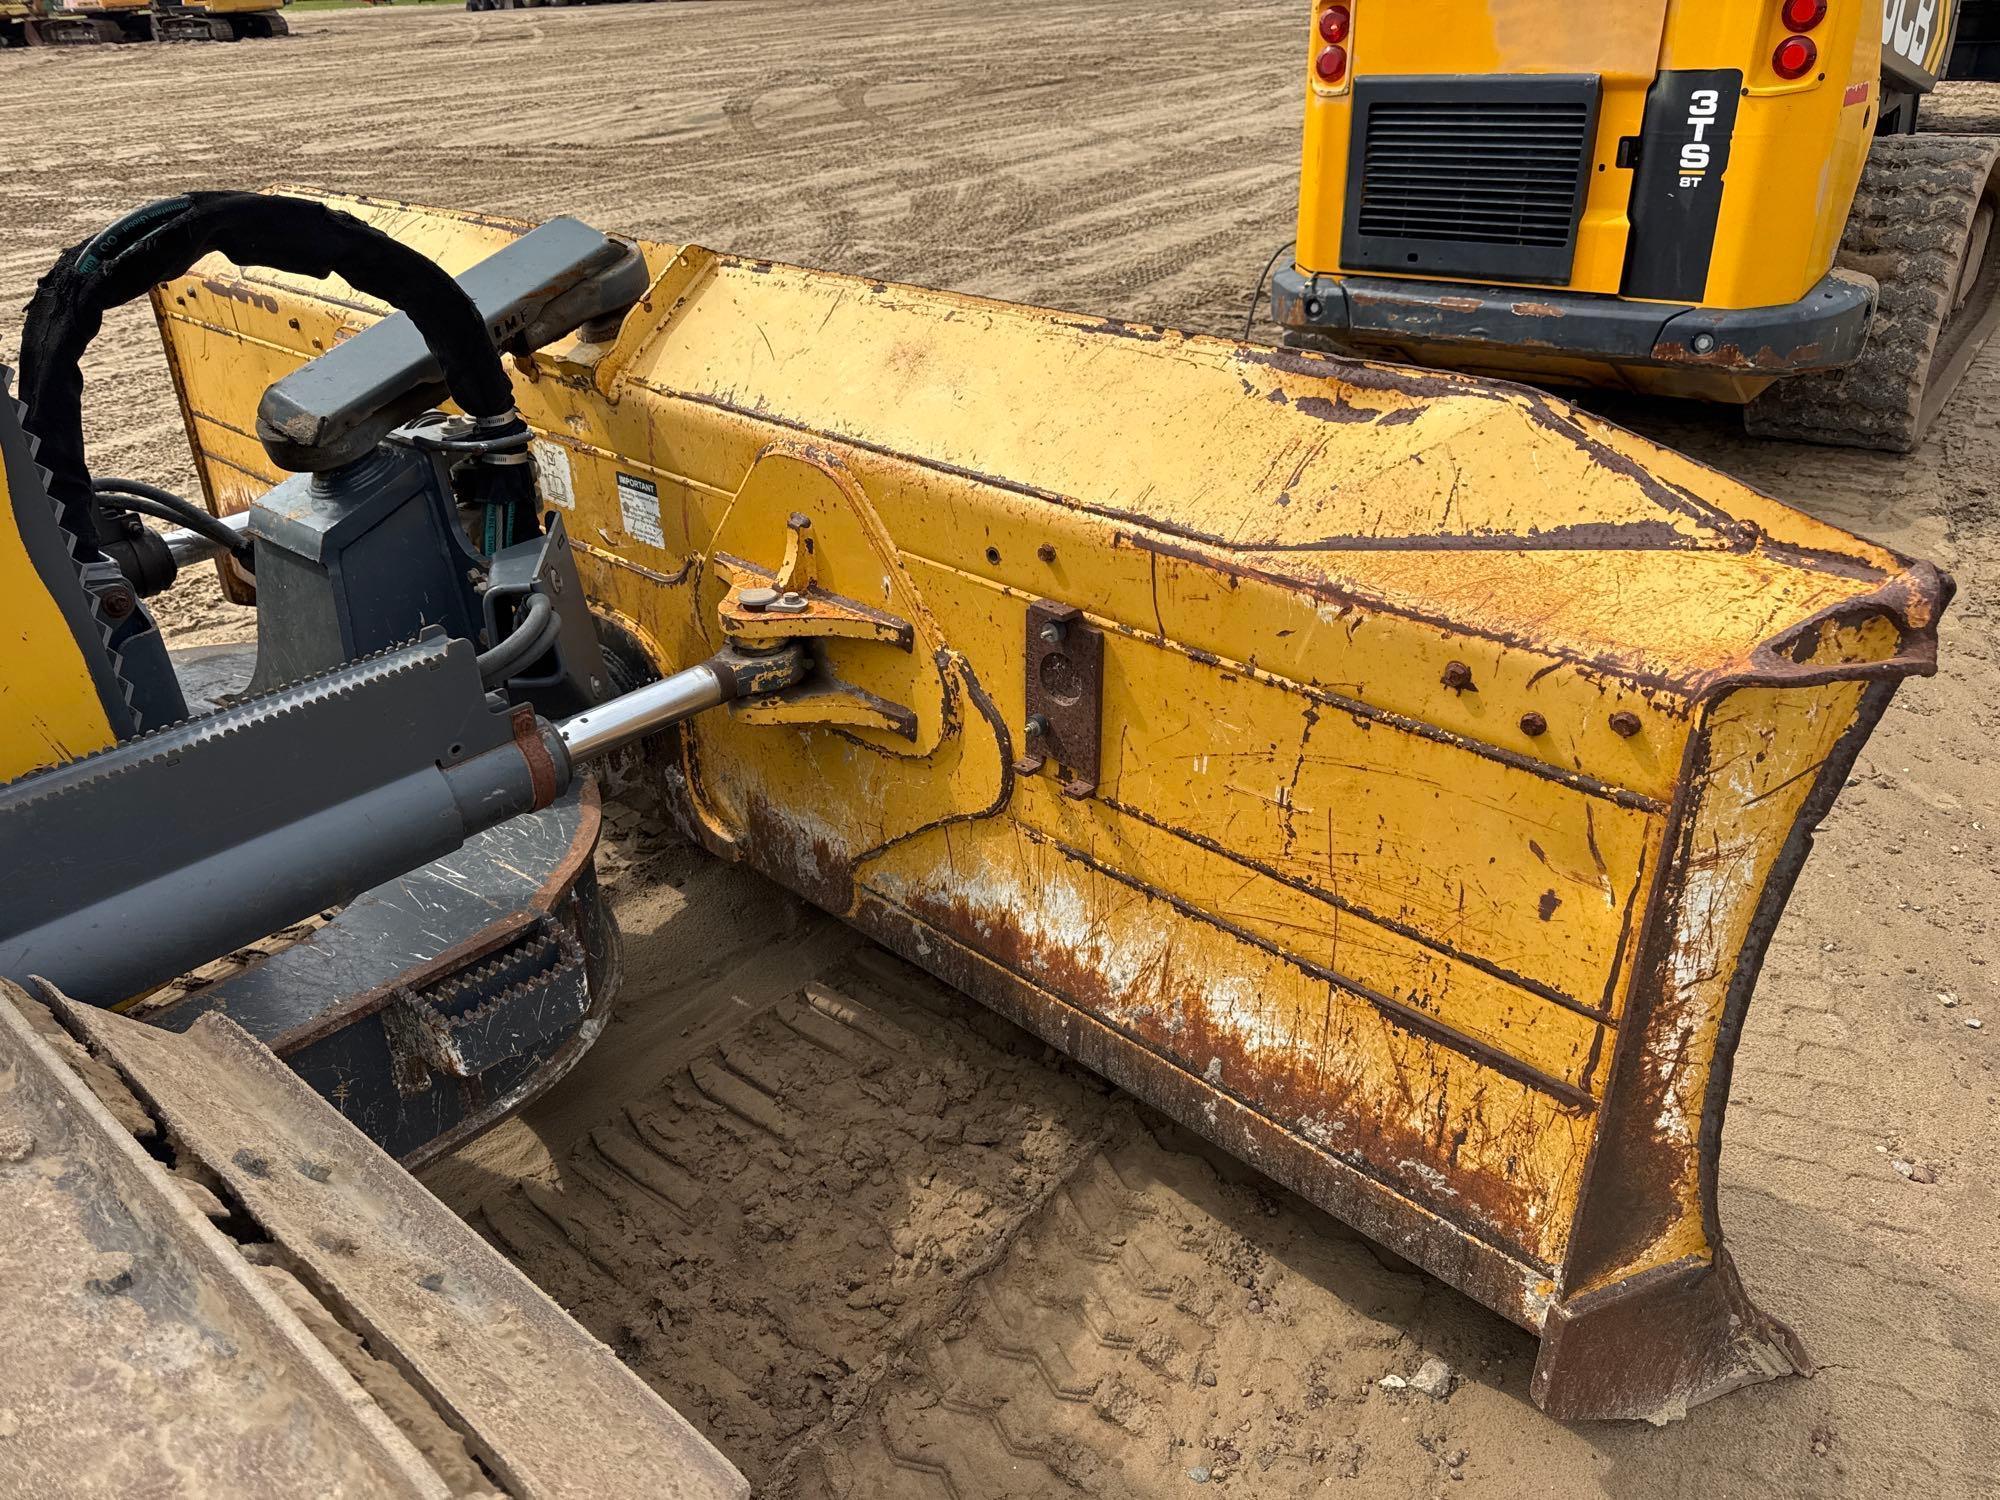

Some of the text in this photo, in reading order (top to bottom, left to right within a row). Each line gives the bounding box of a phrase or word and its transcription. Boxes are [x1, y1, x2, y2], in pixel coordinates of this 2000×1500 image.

[1679, 89, 1719, 169] 3TS
[1679, 176, 1703, 188] 8T
[618, 475, 655, 494] IMPORTANT
